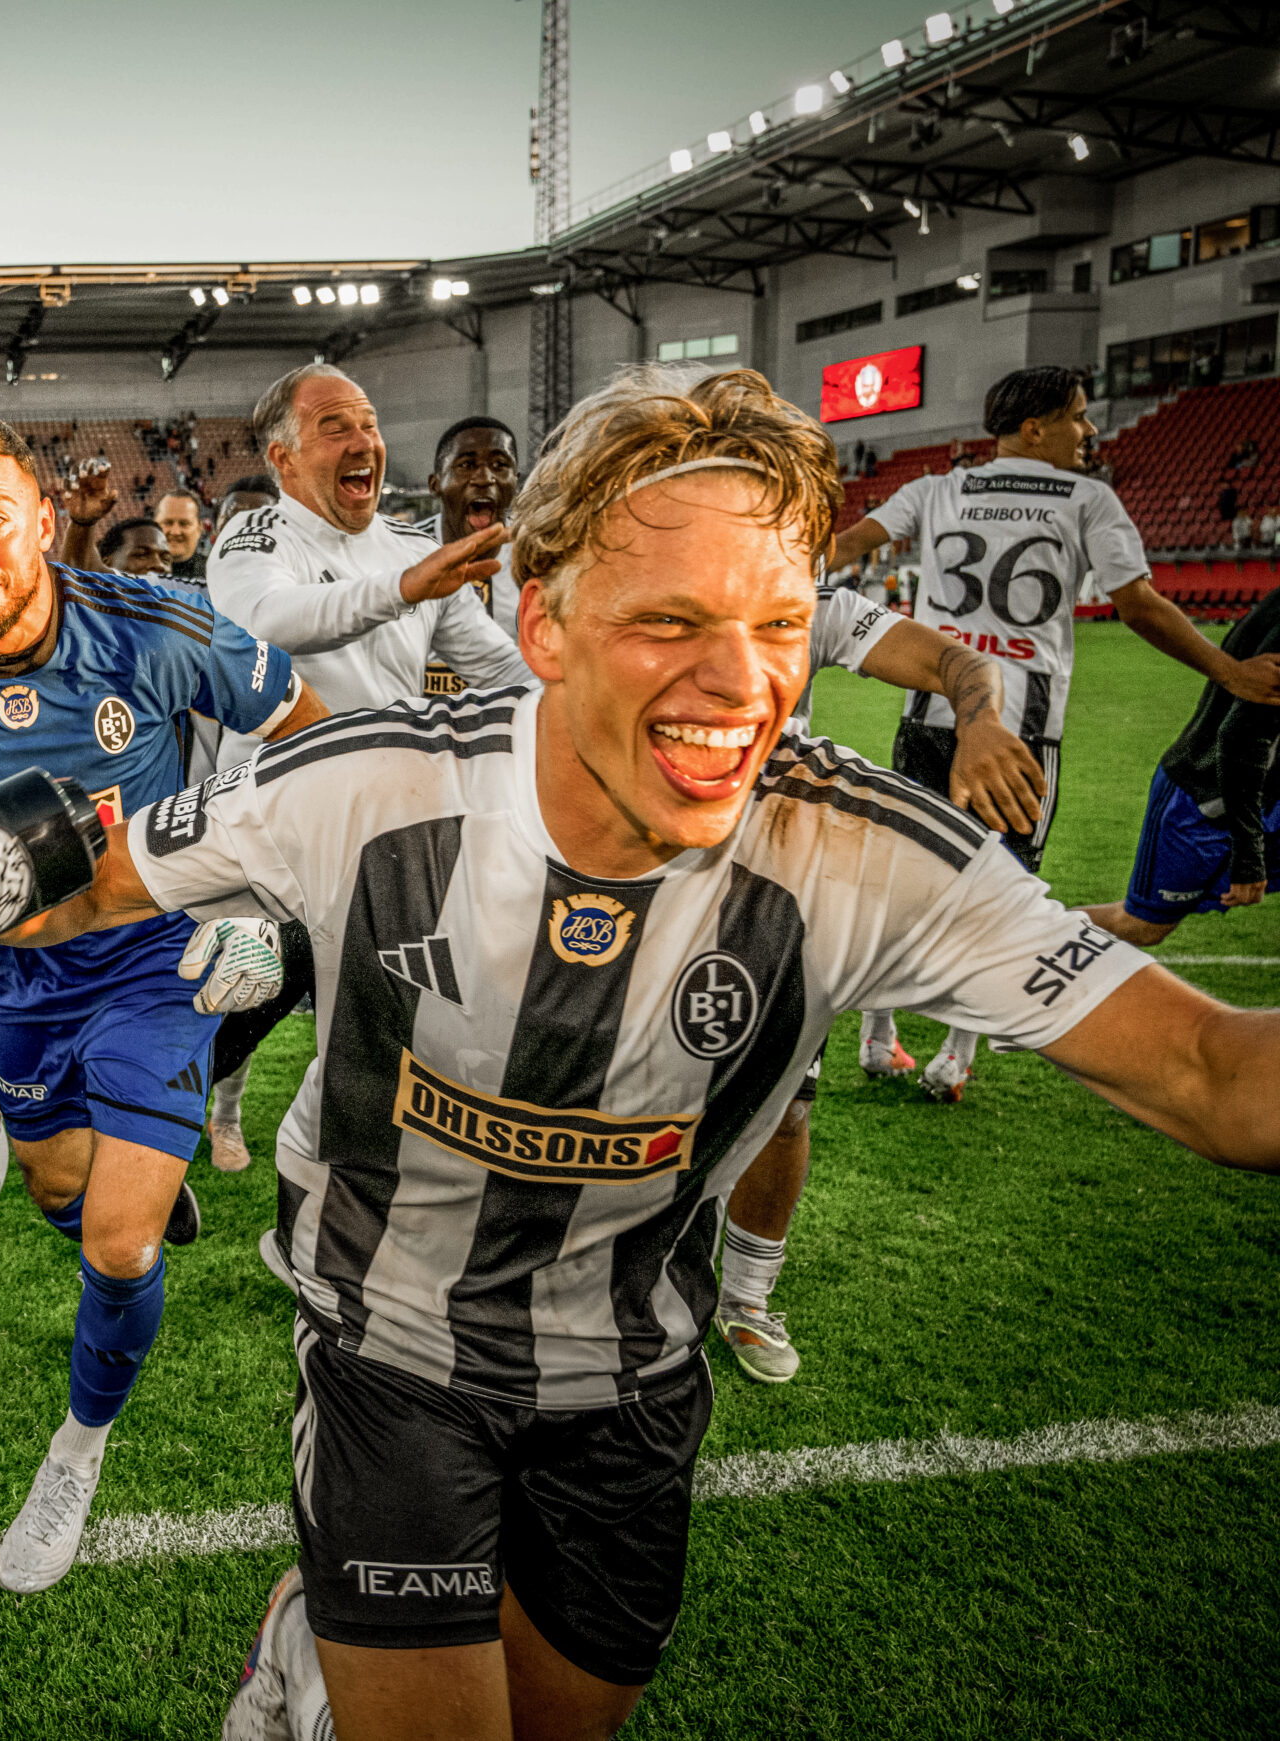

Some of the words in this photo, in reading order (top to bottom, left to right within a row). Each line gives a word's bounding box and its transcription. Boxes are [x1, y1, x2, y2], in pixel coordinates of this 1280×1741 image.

[988, 480, 1072, 493] Automotive
[960, 507, 1055, 524] HEBIBOVIC
[223, 535, 274, 549] UNIBET
[928, 531, 1062, 627] 36
[6, 698, 32, 717] HSB
[170, 782, 201, 838] NIBET
[562, 915, 614, 943] HSB
[411, 1081, 642, 1166] OHLSSONS
[343, 1560, 496, 1597] TEAMAB
